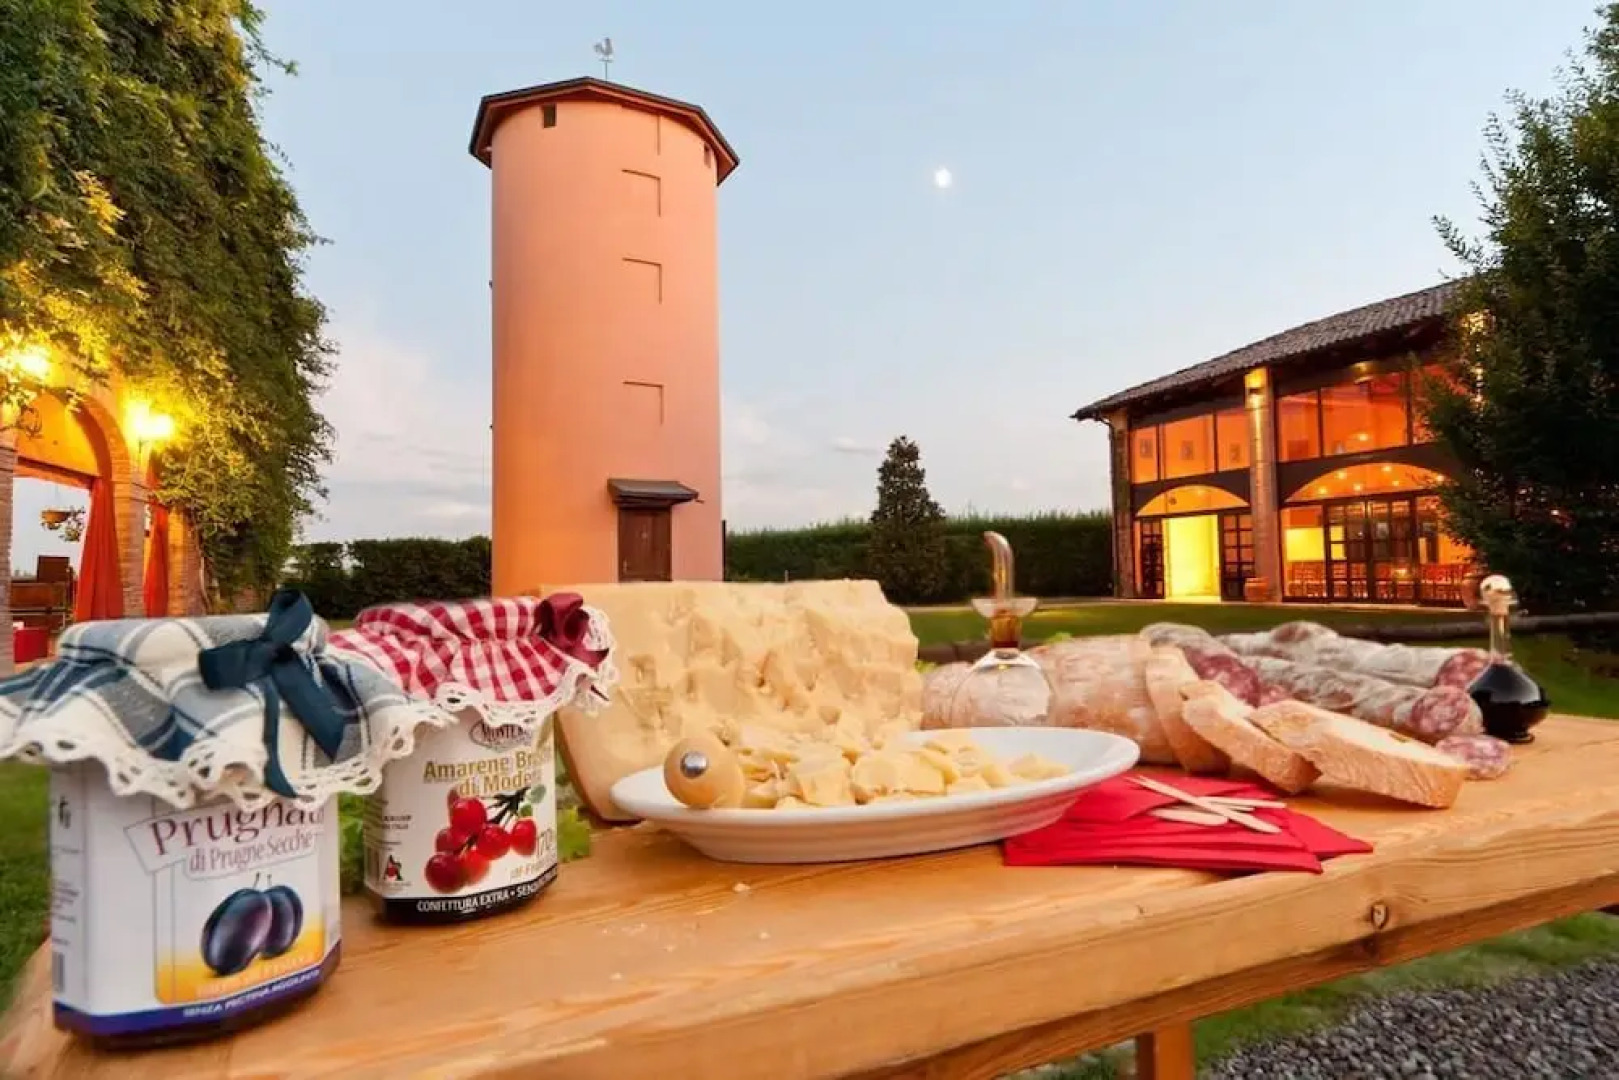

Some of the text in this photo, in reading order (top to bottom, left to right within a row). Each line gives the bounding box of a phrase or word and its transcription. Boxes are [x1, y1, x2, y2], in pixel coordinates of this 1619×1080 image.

[423, 757, 509, 779] Amarene
[459, 777, 477, 796] di
[190, 848, 205, 872] di
[210, 842, 265, 871] Prugne
[417, 896, 479, 913] CONFETTURA
[480, 889, 510, 906] EXTRA
